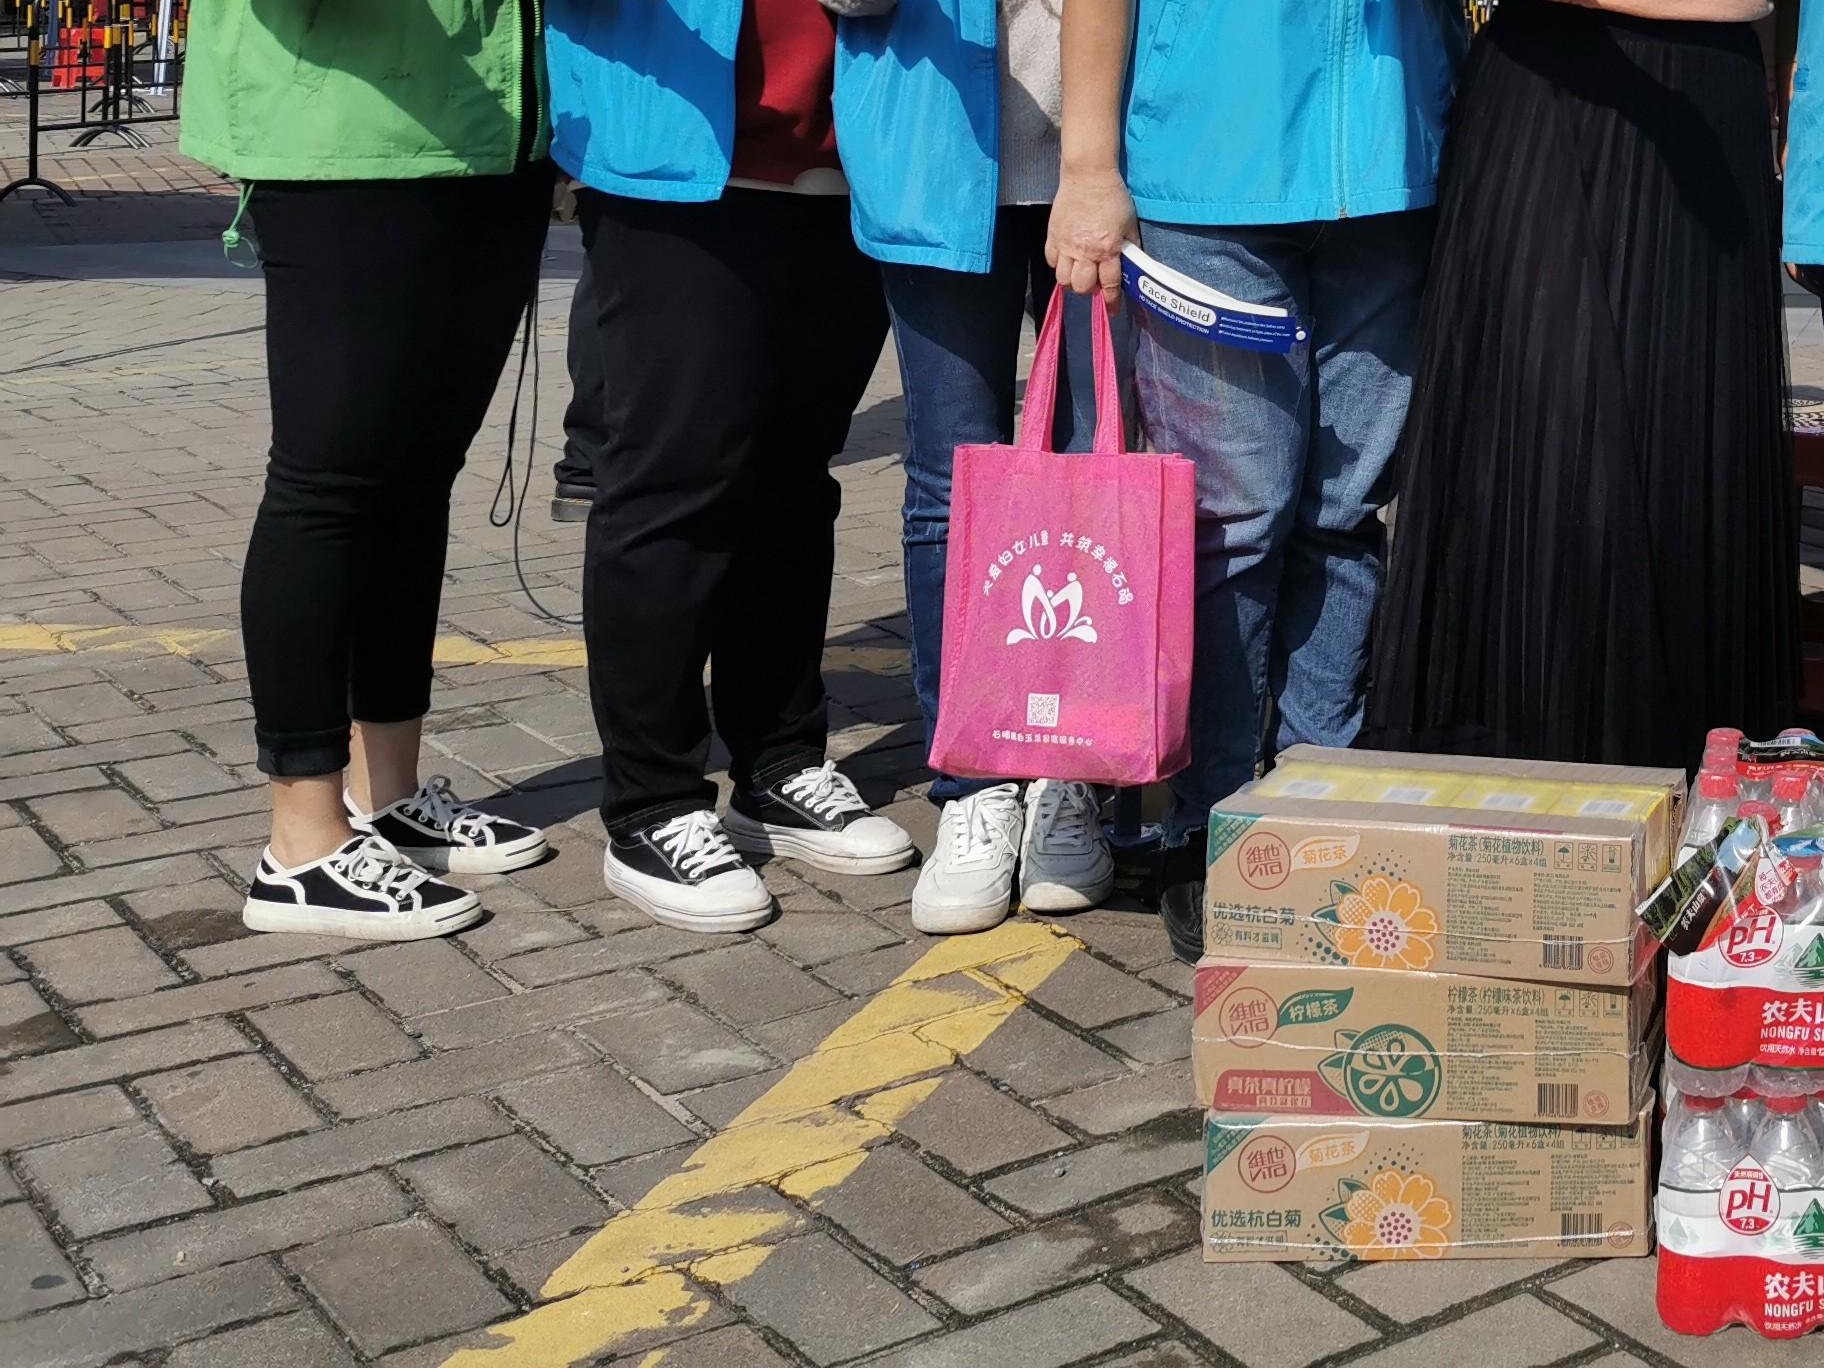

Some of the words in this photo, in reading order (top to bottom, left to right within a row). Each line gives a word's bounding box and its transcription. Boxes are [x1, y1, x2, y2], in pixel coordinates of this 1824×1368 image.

[1142, 278, 1168, 304] Face
[1170, 298, 1211, 323] Shield
[1301, 845, 1348, 865] 菊花茶
[1212, 901, 1296, 925] 优选杭白菊
[1726, 916, 1777, 955] pH
[1288, 998, 1340, 1022] 柠檬茶
[1760, 1026, 1810, 1040] NONGFU
[1308, 1141, 1357, 1165] 菊花茶
[1726, 1182, 1772, 1219] pH
[1211, 1209, 1302, 1228] 优选杭白菊
[1764, 1299, 1814, 1318] NONGFU
